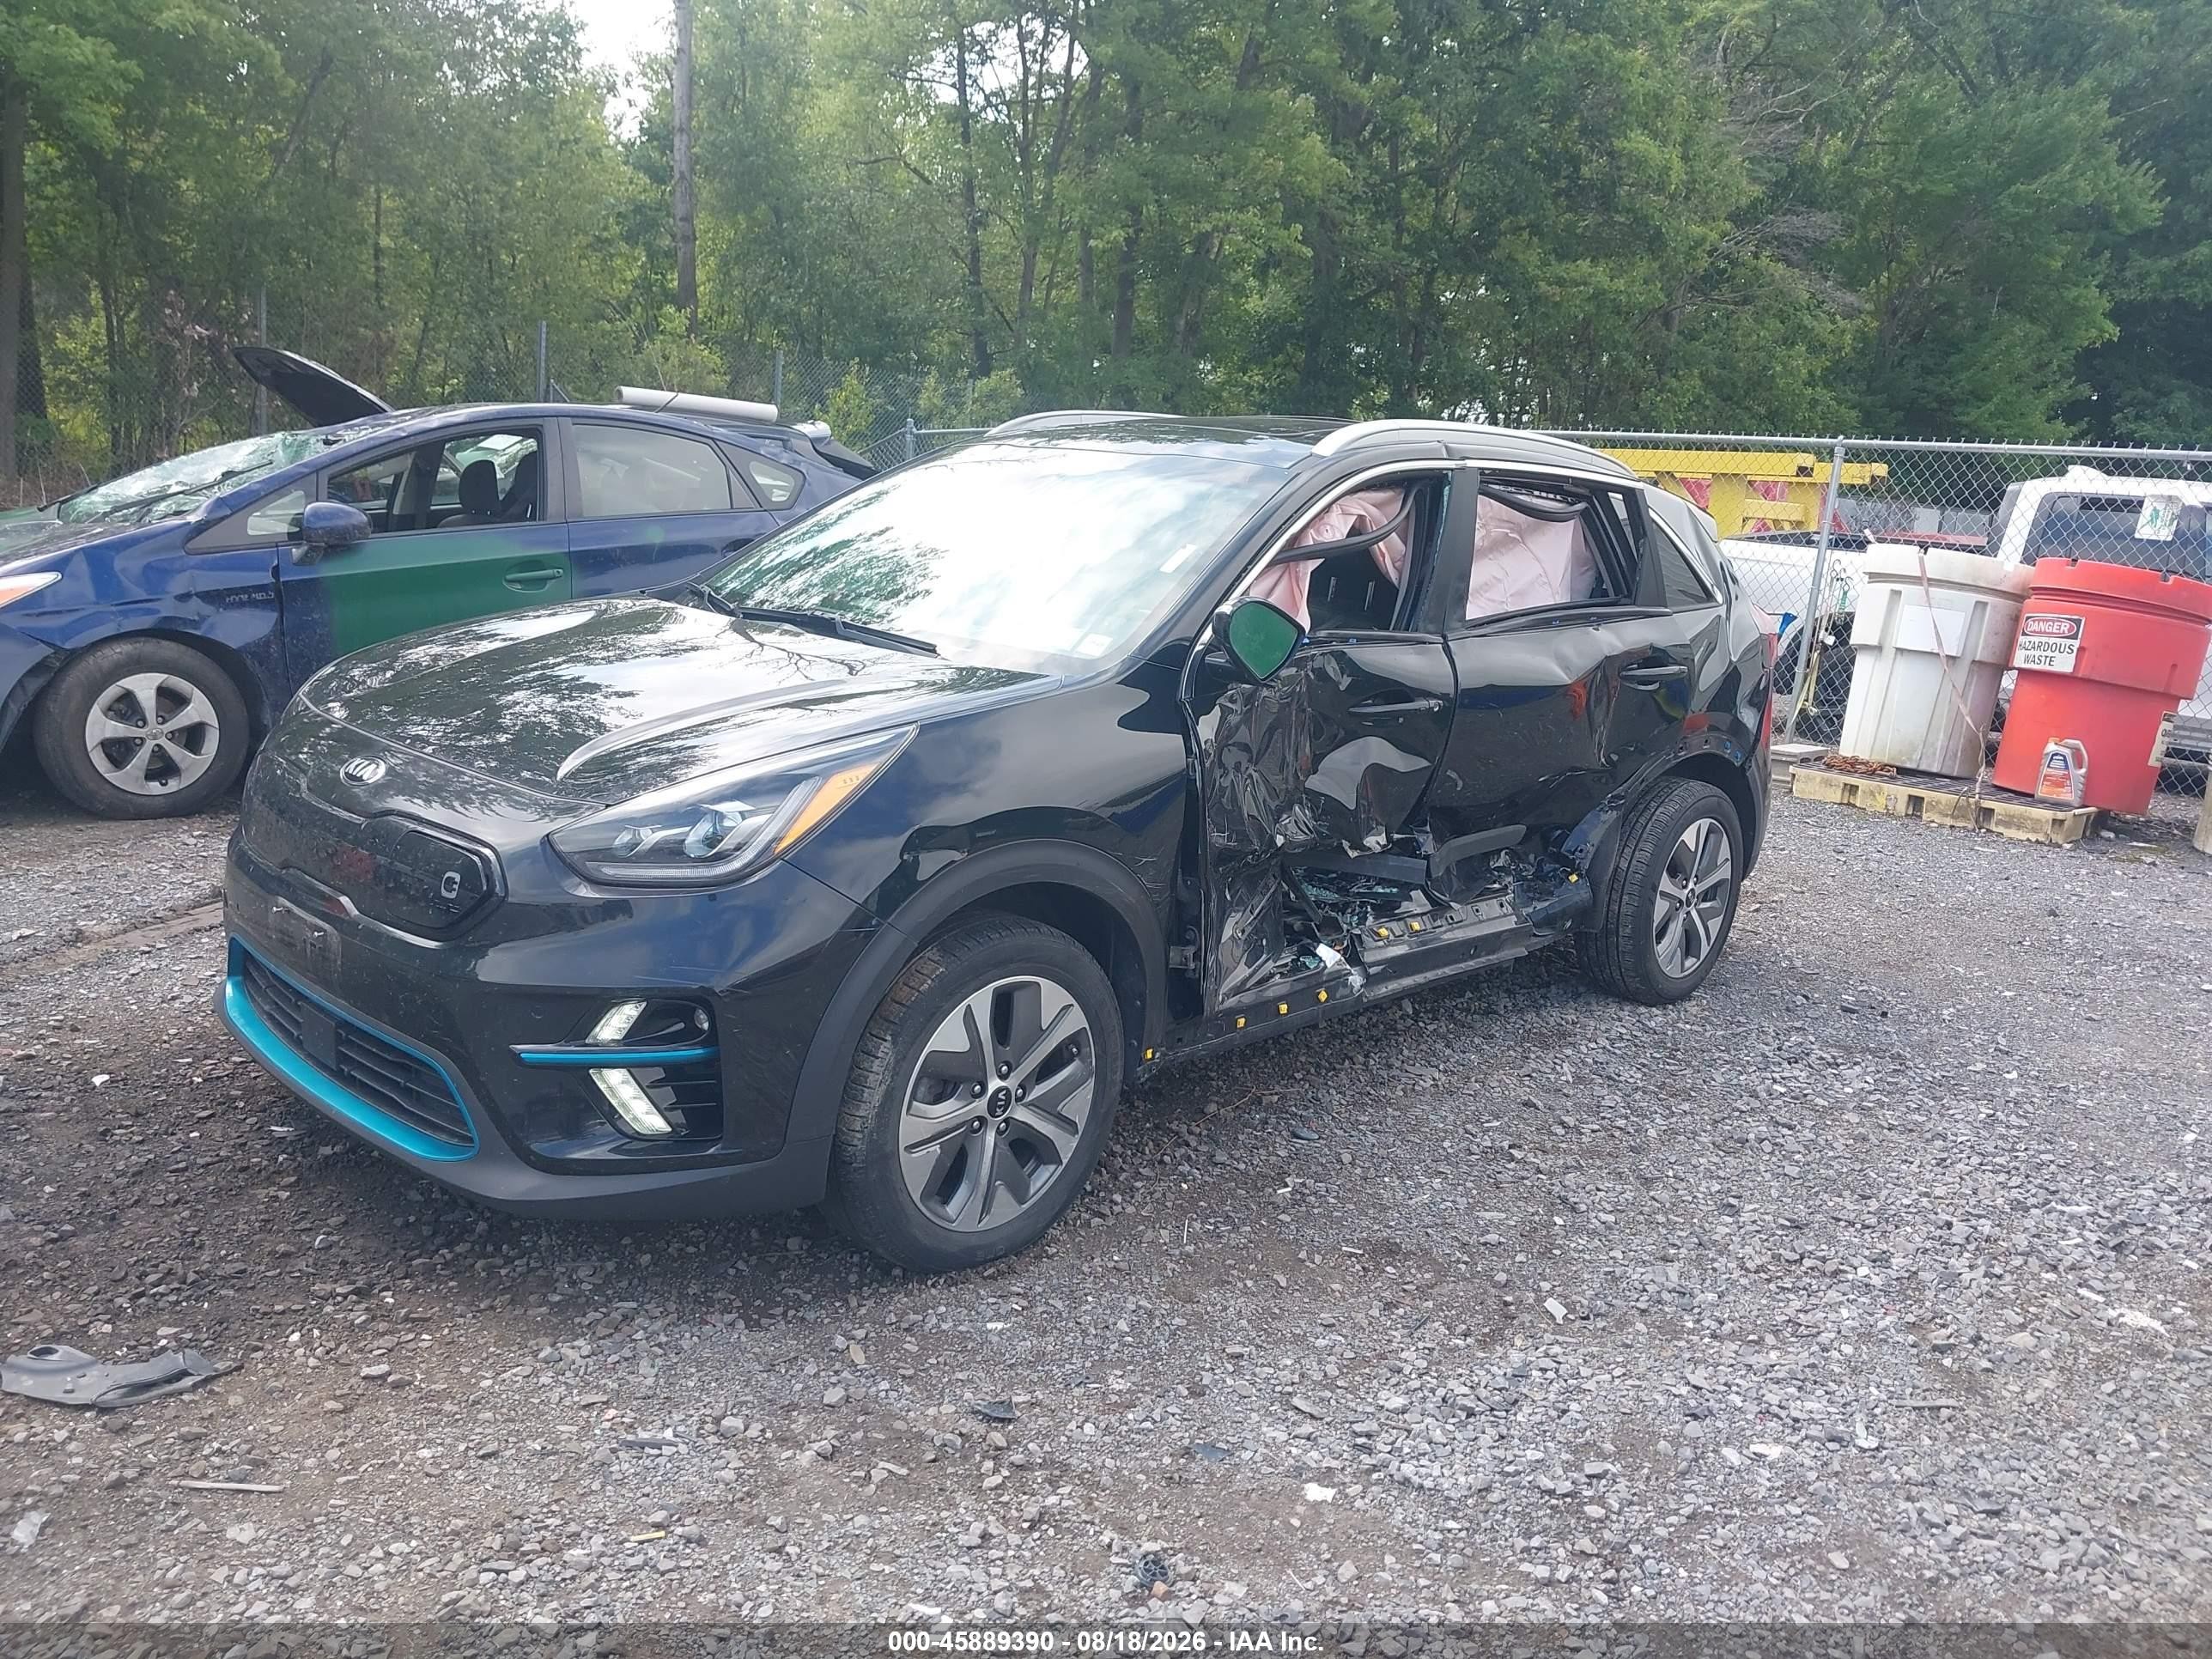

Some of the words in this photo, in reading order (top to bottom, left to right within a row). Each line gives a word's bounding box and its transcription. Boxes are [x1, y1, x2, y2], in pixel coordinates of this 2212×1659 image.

[2027, 620, 2070, 634] DANGER
[2019, 640, 2075, 655] HAZARDOUS
[2023, 653, 2057, 667] WASTE
[345, 758, 378, 781] KIA
[995, 1090, 1006, 1116] KIA
